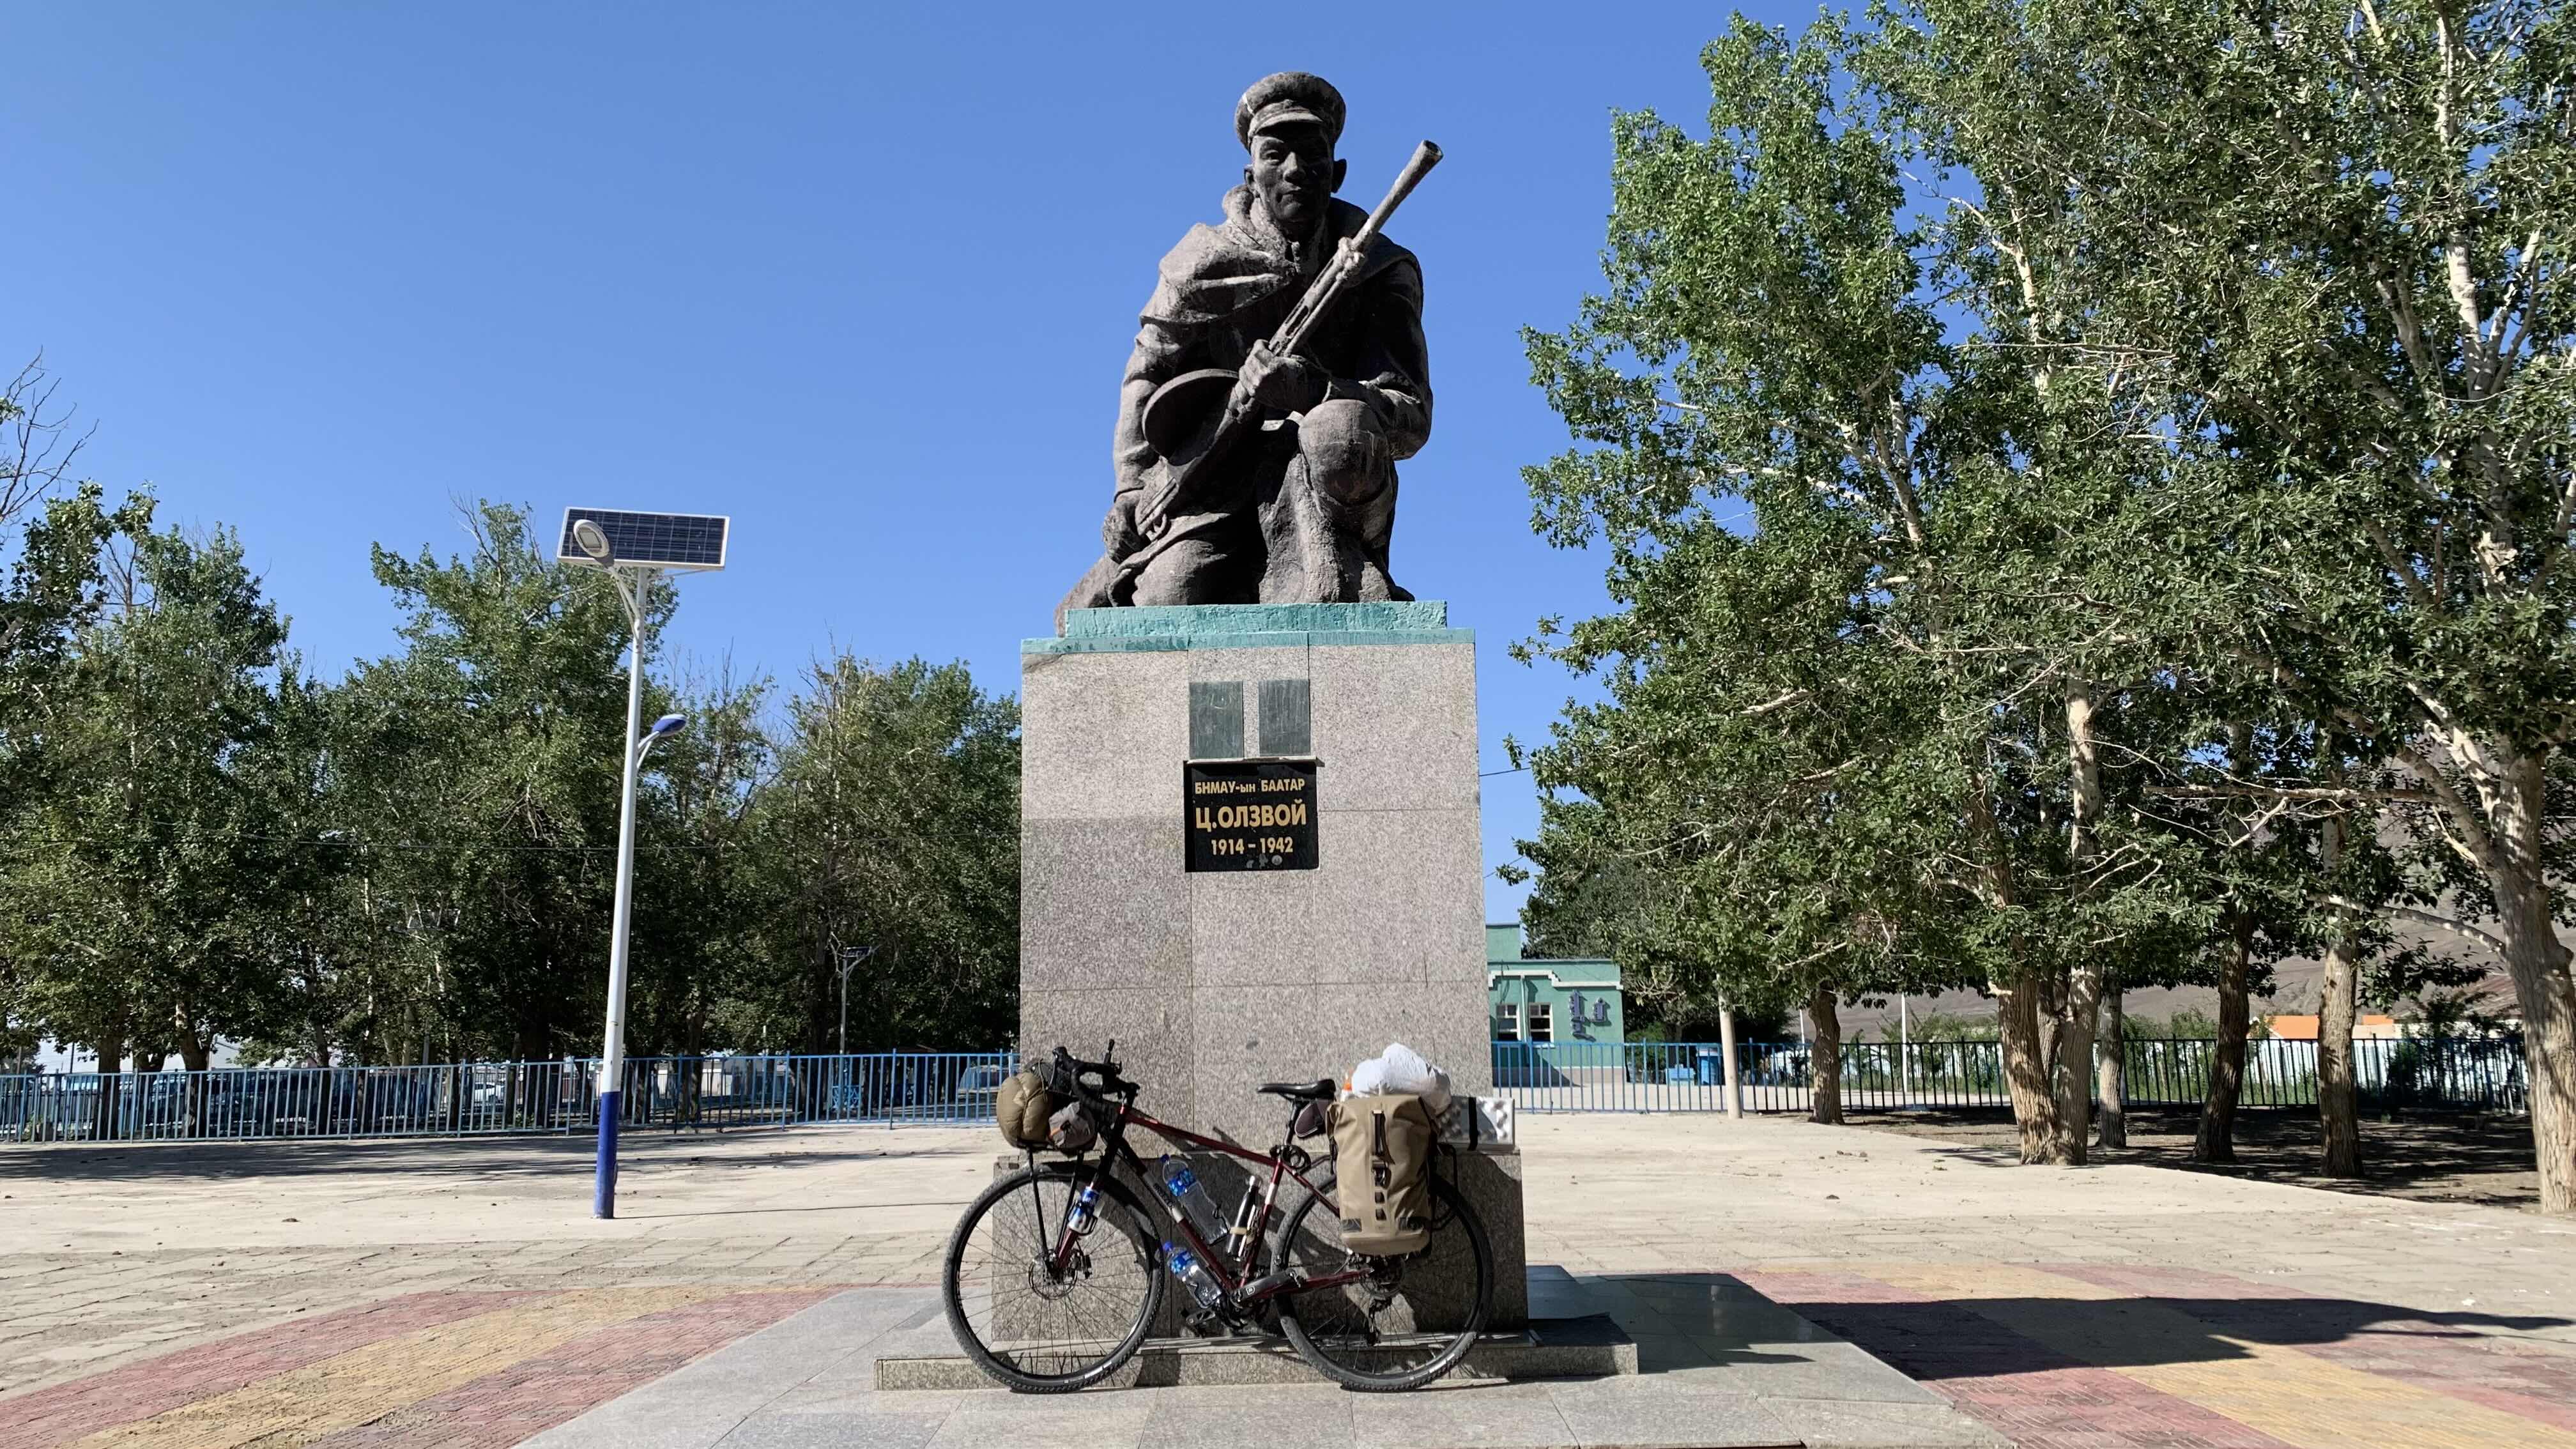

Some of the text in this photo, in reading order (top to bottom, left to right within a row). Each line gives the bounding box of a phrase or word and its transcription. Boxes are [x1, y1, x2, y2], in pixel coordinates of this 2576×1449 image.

[1195, 778, 1305, 793] БНМАУ-ын БААТАР
[1195, 799, 1307, 832] Ц.ОЛЗВОЙ
[1211, 838, 1245, 855] 1914
[1261, 836, 1293, 853] 1942
